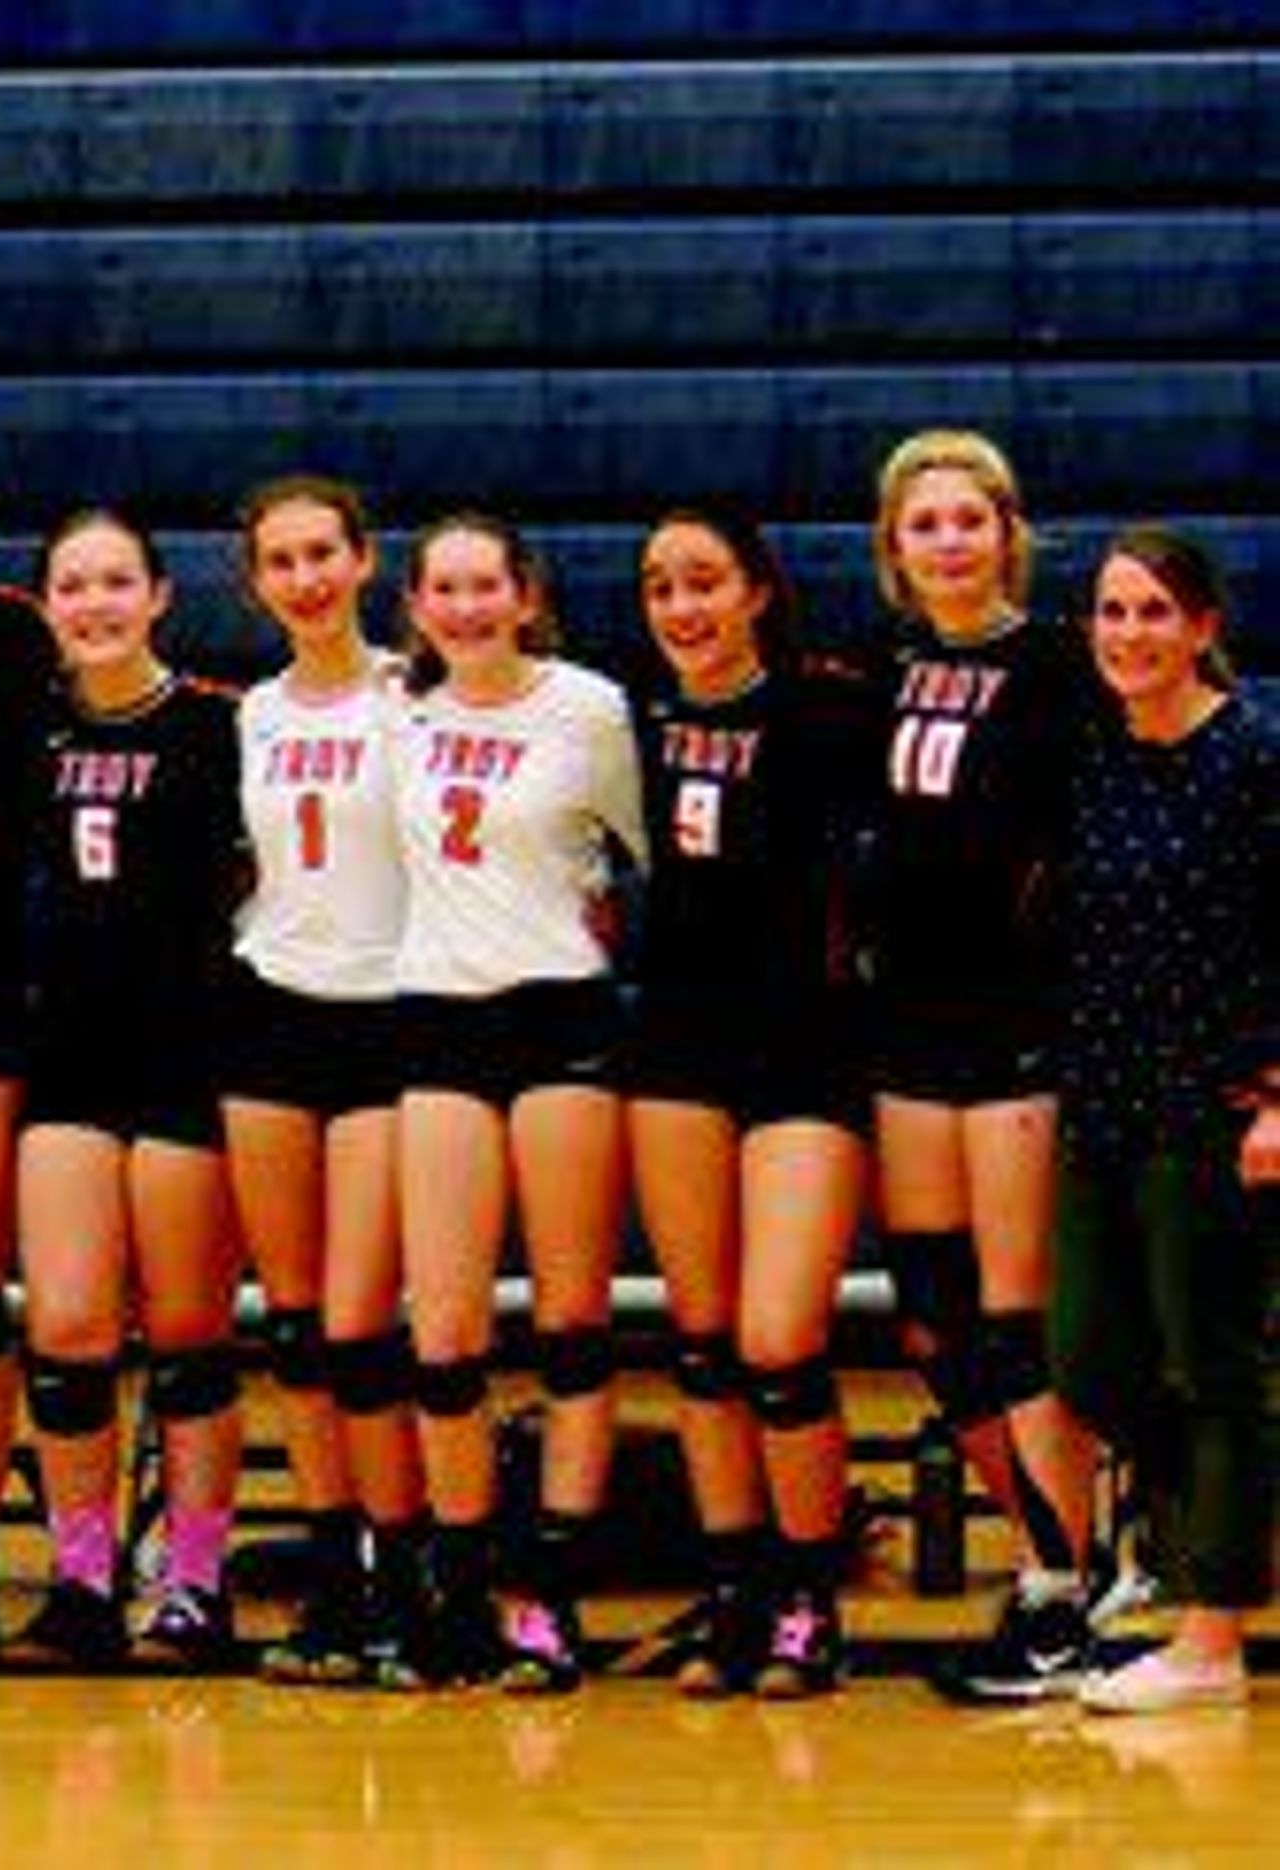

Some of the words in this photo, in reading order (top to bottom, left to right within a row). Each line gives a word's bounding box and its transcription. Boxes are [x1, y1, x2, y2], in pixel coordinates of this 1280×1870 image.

[895, 661, 1009, 714] TROY
[54, 753, 157, 799] TROY
[263, 737, 365, 784] TROY
[425, 731, 526, 783] TROY
[661, 724, 766, 778] TROY
[890, 715, 967, 796] 10
[72, 806, 116, 880] 6
[296, 792, 325, 869] 1
[441, 786, 484, 866] 2
[672, 778, 720, 857] 9
